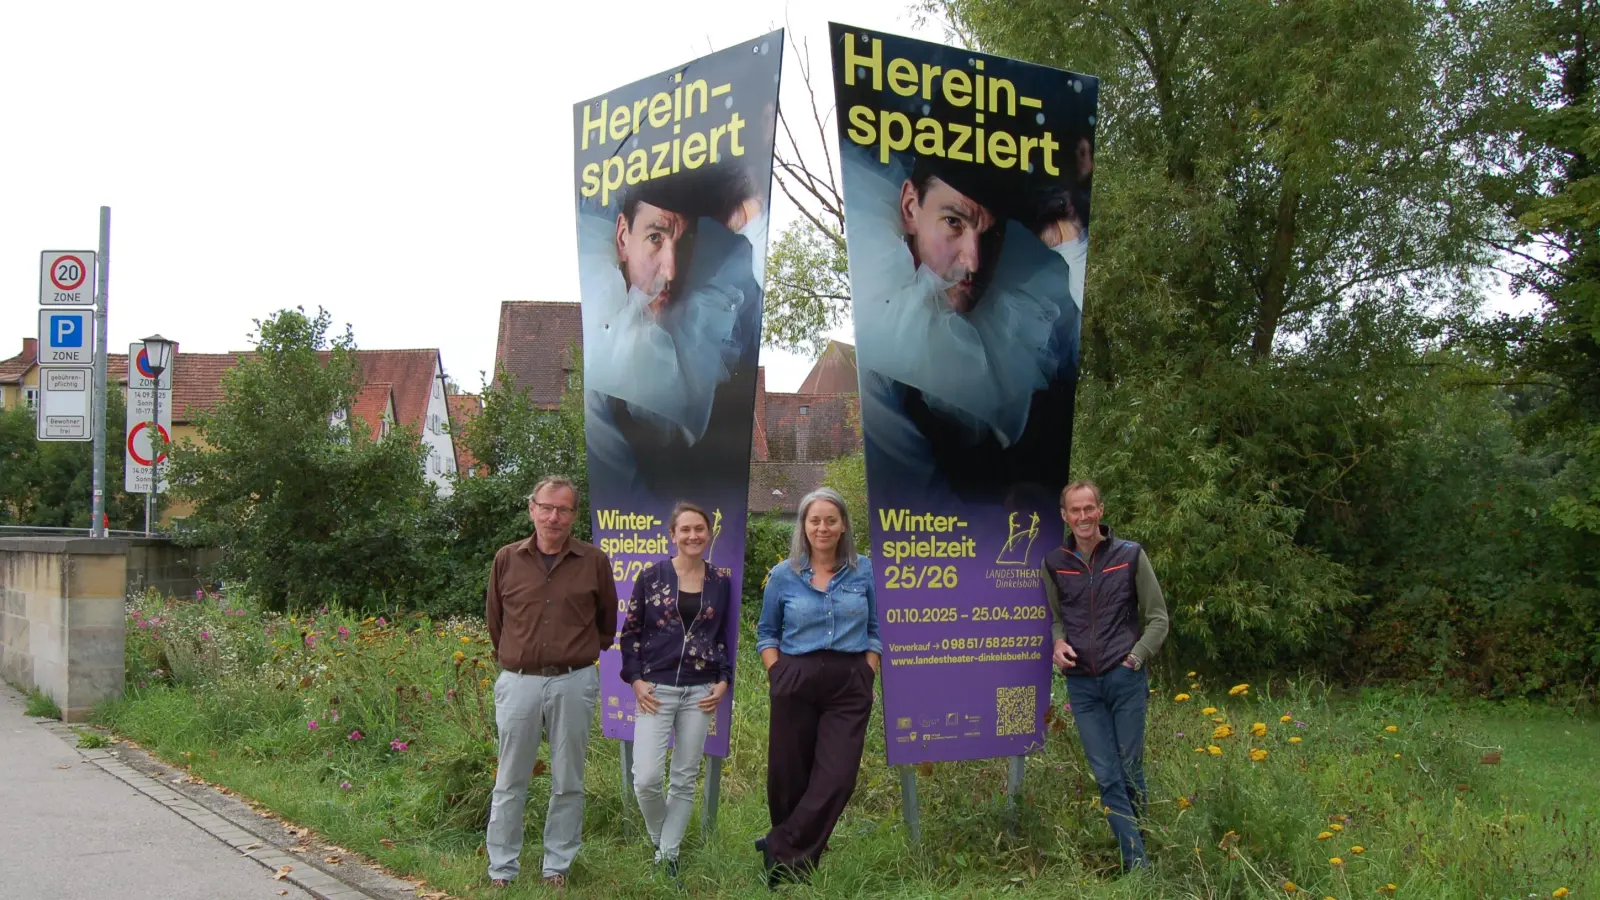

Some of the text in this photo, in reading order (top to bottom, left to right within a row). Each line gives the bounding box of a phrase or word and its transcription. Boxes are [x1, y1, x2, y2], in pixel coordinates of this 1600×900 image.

[844, 32, 1042, 117] Herein-
[581, 72, 731, 150] Herein-
[847, 105, 1060, 176] spaziert
[581, 112, 745, 207] spaziert
[58, 264, 79, 281] 20
[54, 292, 81, 302] ZONE
[57, 319, 76, 344] P
[52, 351, 80, 361] ZONE
[597, 509, 662, 531] Winter-
[879, 508, 968, 532] Winter-
[600, 533, 669, 558] spielzeit
[882, 535, 976, 564] spielzeit
[611, 561, 654, 582] 5/2
[884, 565, 958, 589] 25/26
[985, 568, 1042, 579] LANDESTHEAT
[995, 578, 1040, 589] Dinkelsbühl
[886, 607, 958, 623] 01.10.2025
[971, 605, 1047, 621] 25.04.2026
[888, 641, 931, 652] Vorverkauf
[890, 651, 1041, 667] www.landestheater-dinkelsbuehl.de
